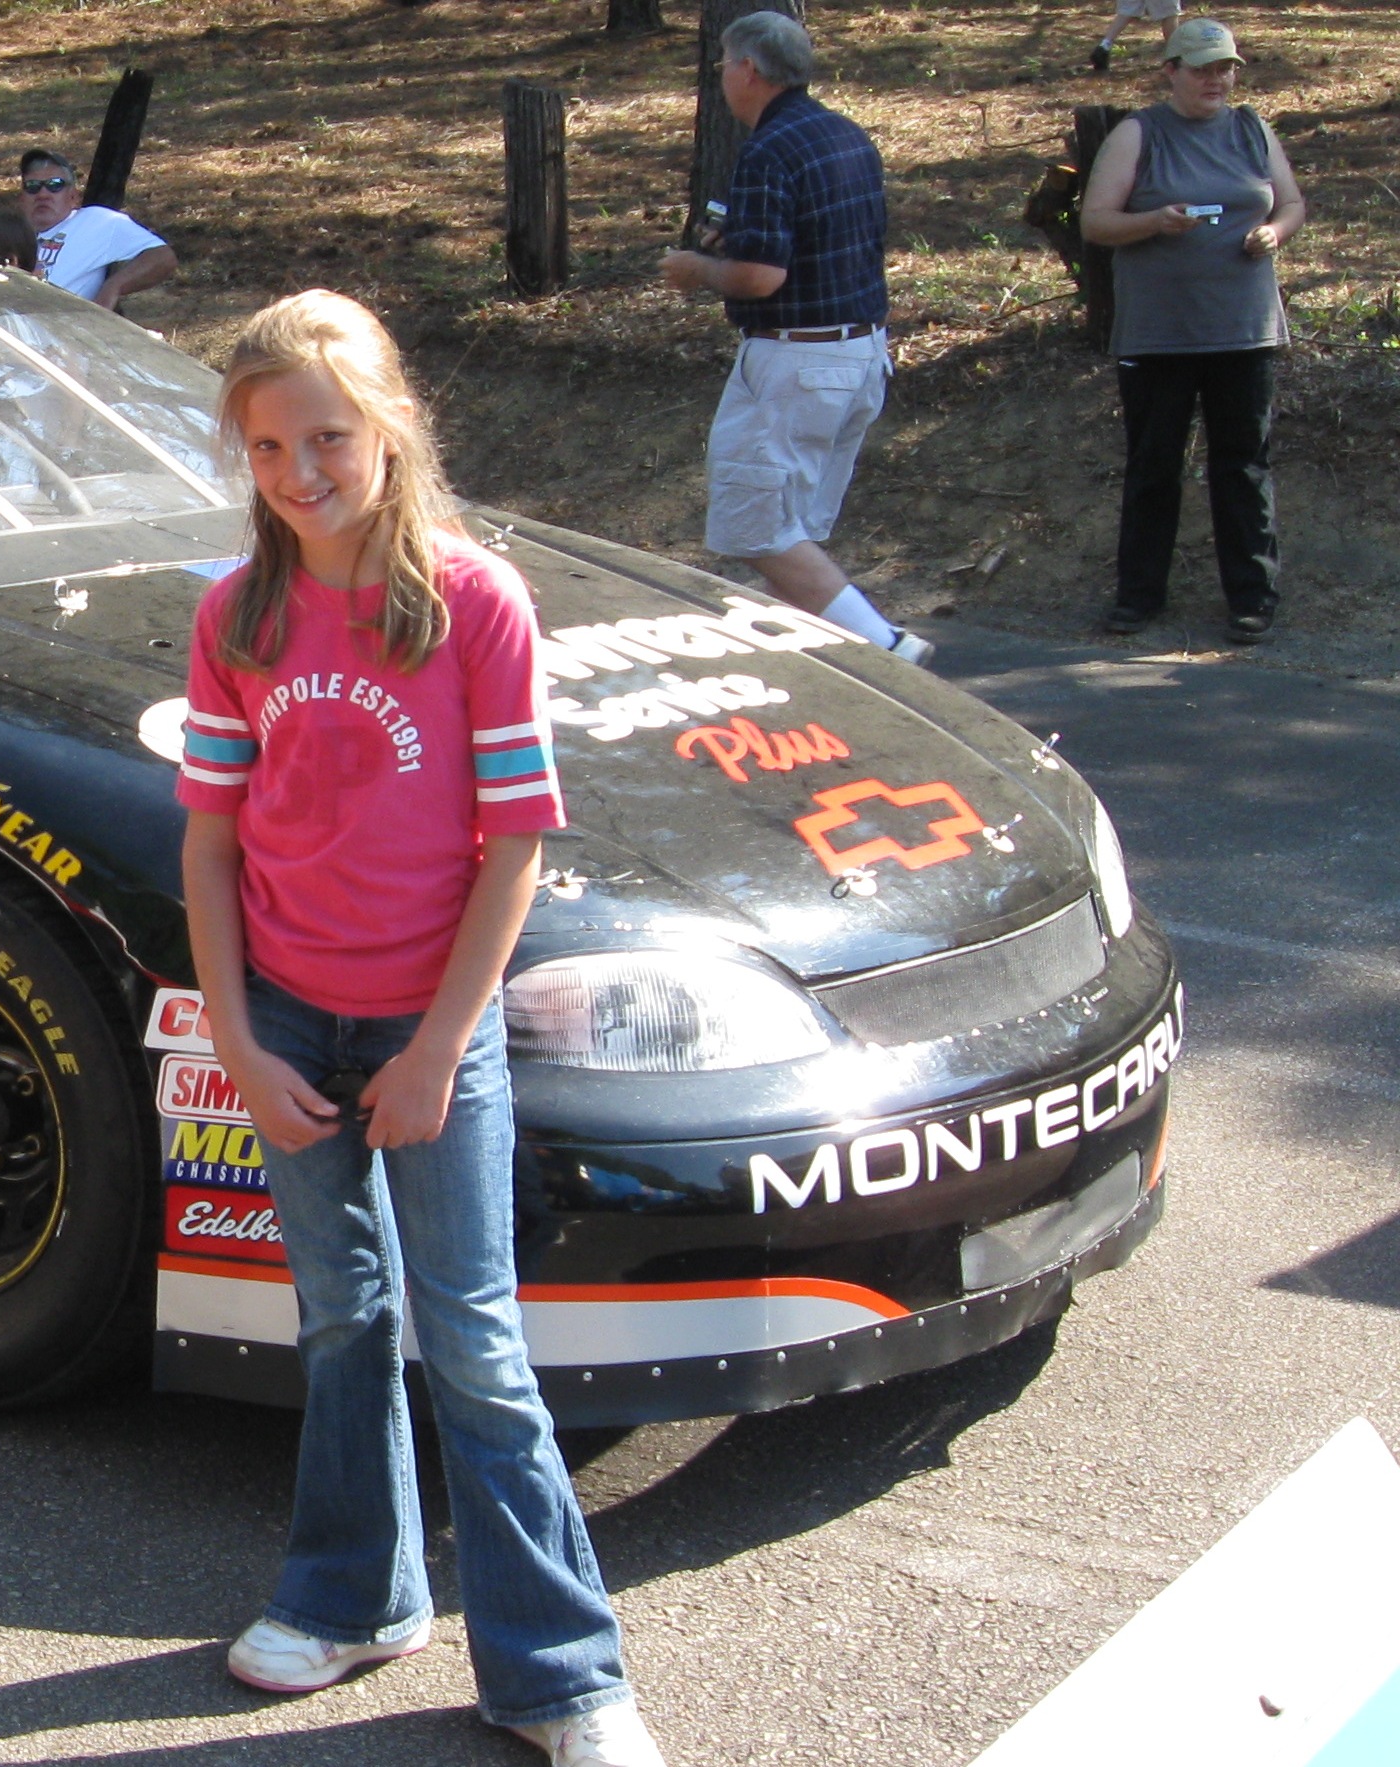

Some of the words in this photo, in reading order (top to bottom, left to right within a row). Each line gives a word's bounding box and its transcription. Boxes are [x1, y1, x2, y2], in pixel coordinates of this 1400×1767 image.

[675, 716, 850, 783] Plus
[169, 1121, 264, 1168] MO
[176, 1160, 268, 1186] CHASSIS
